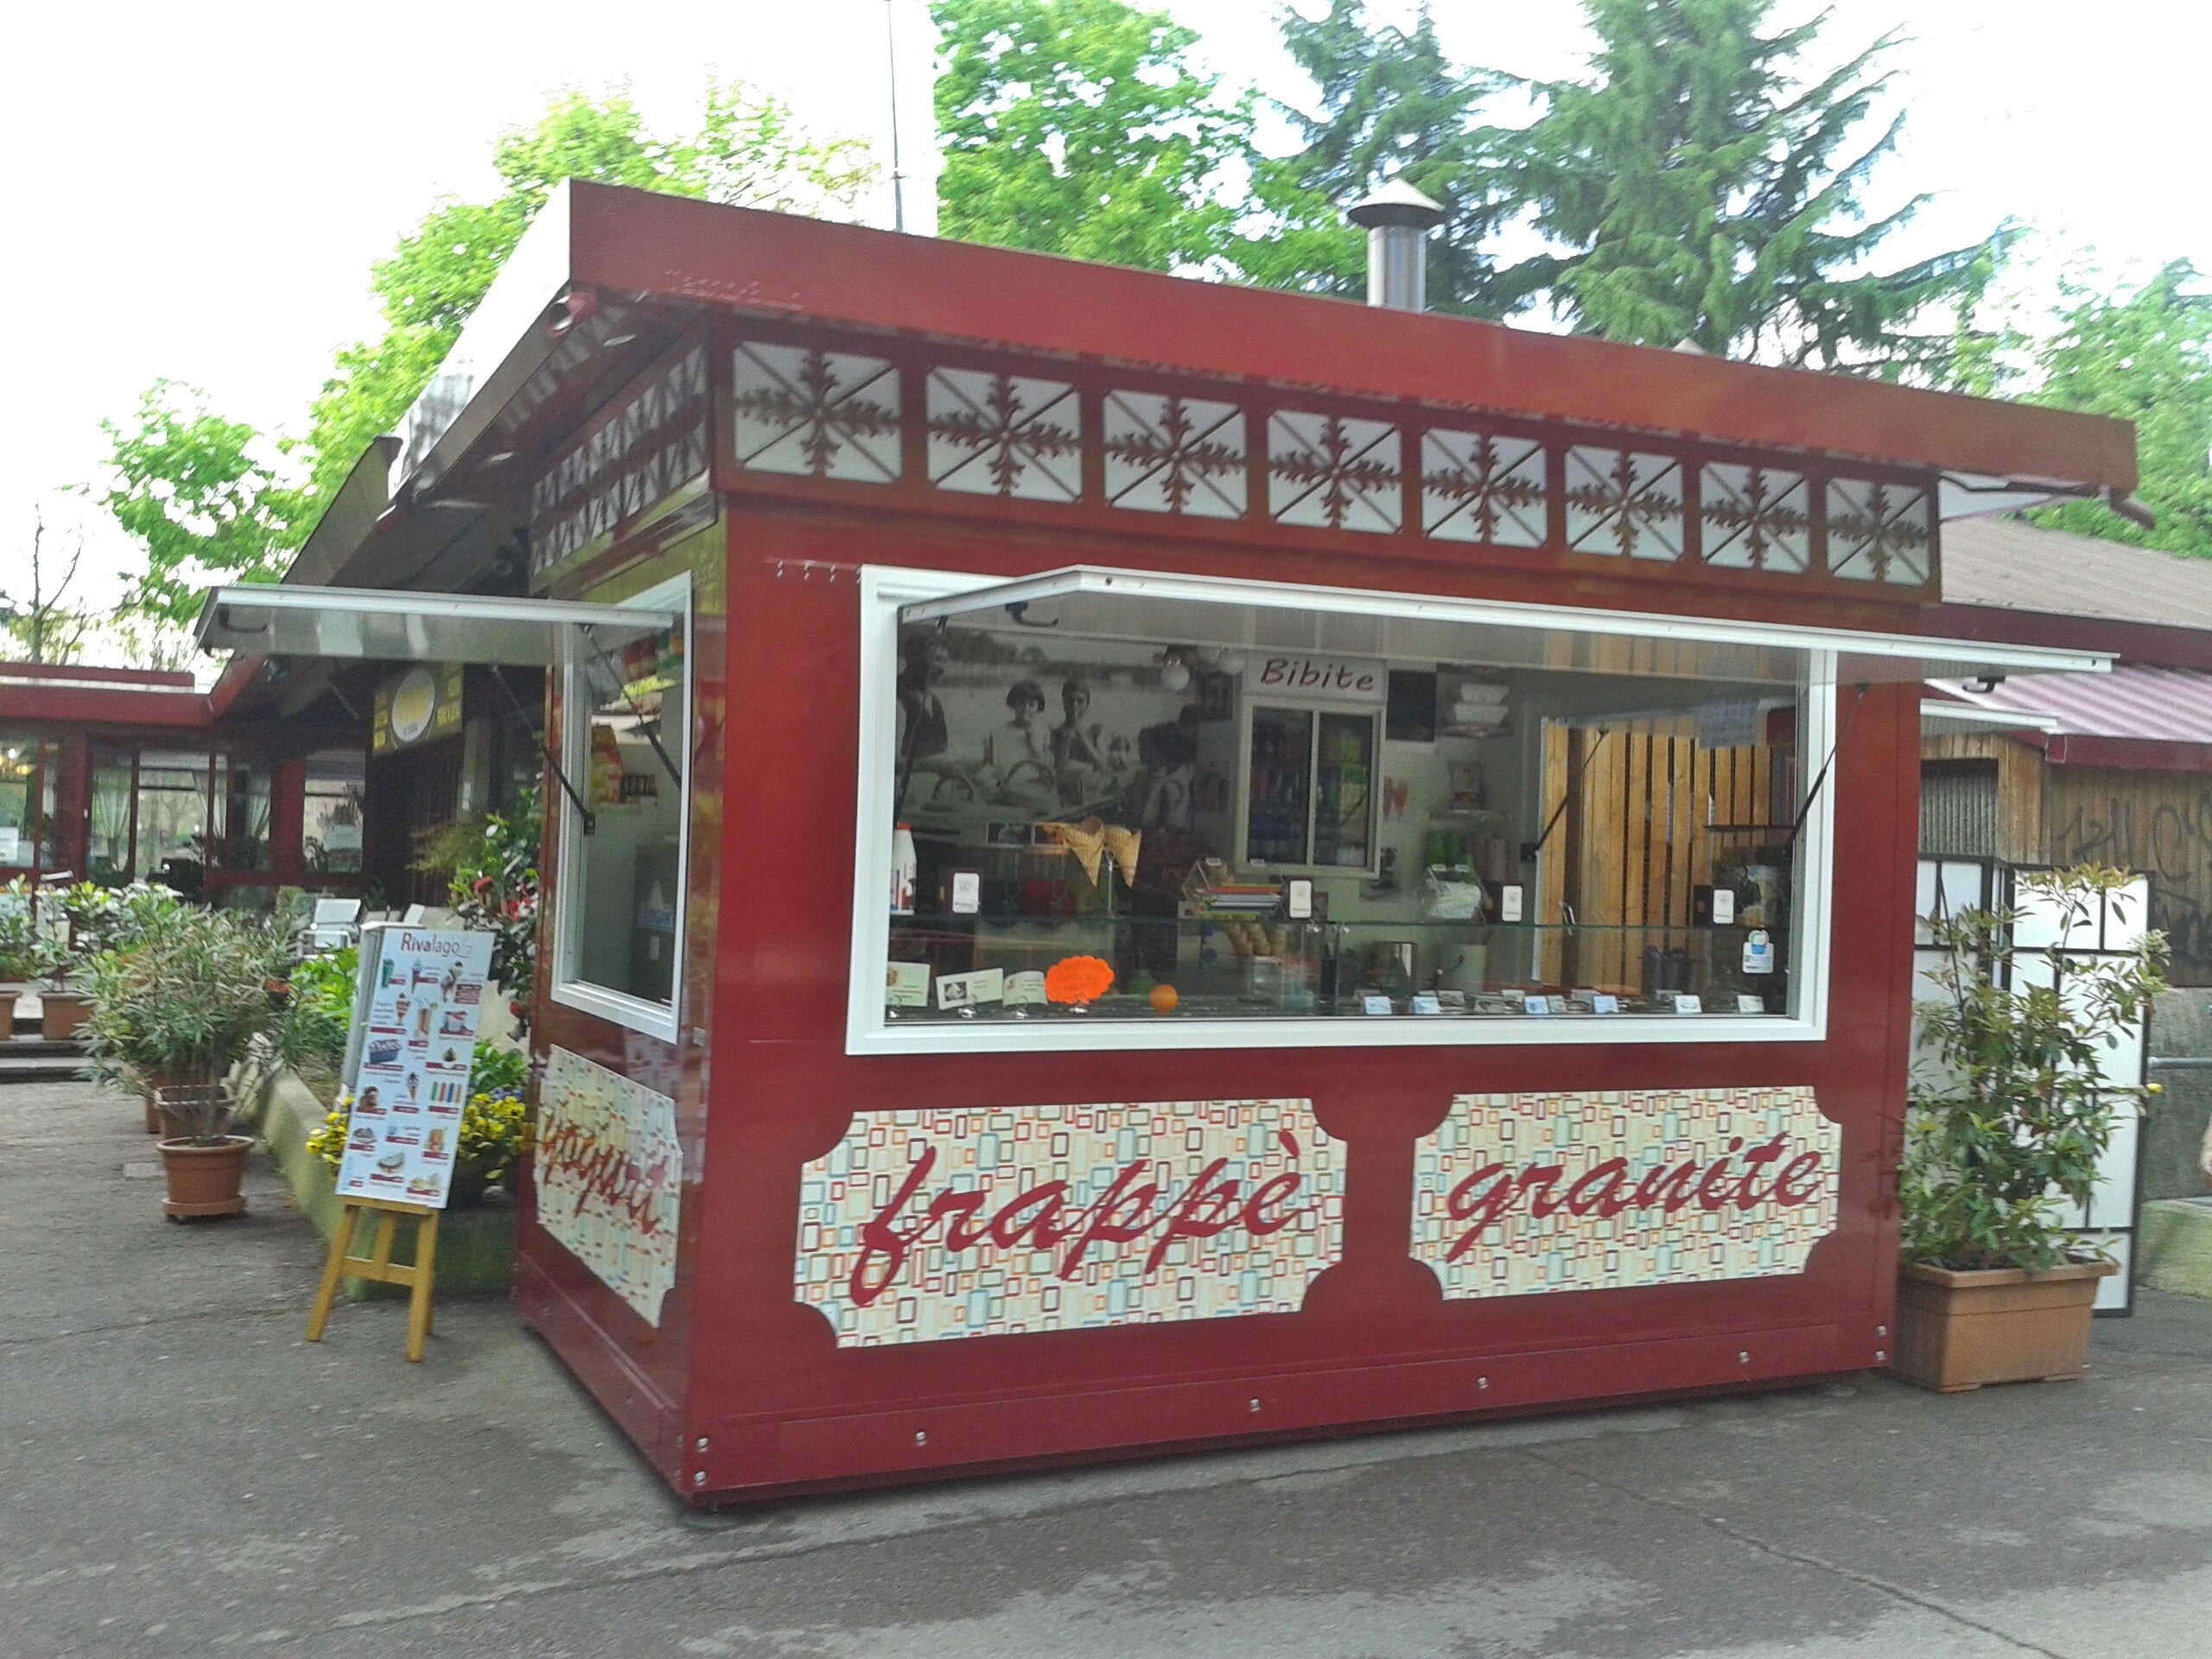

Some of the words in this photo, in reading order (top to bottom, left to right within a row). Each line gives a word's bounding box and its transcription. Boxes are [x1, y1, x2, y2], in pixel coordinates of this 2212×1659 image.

[1260, 658, 1374, 691] Bibite
[401, 931, 461, 957] Rivalago
[1446, 1131, 1822, 1263] granite
